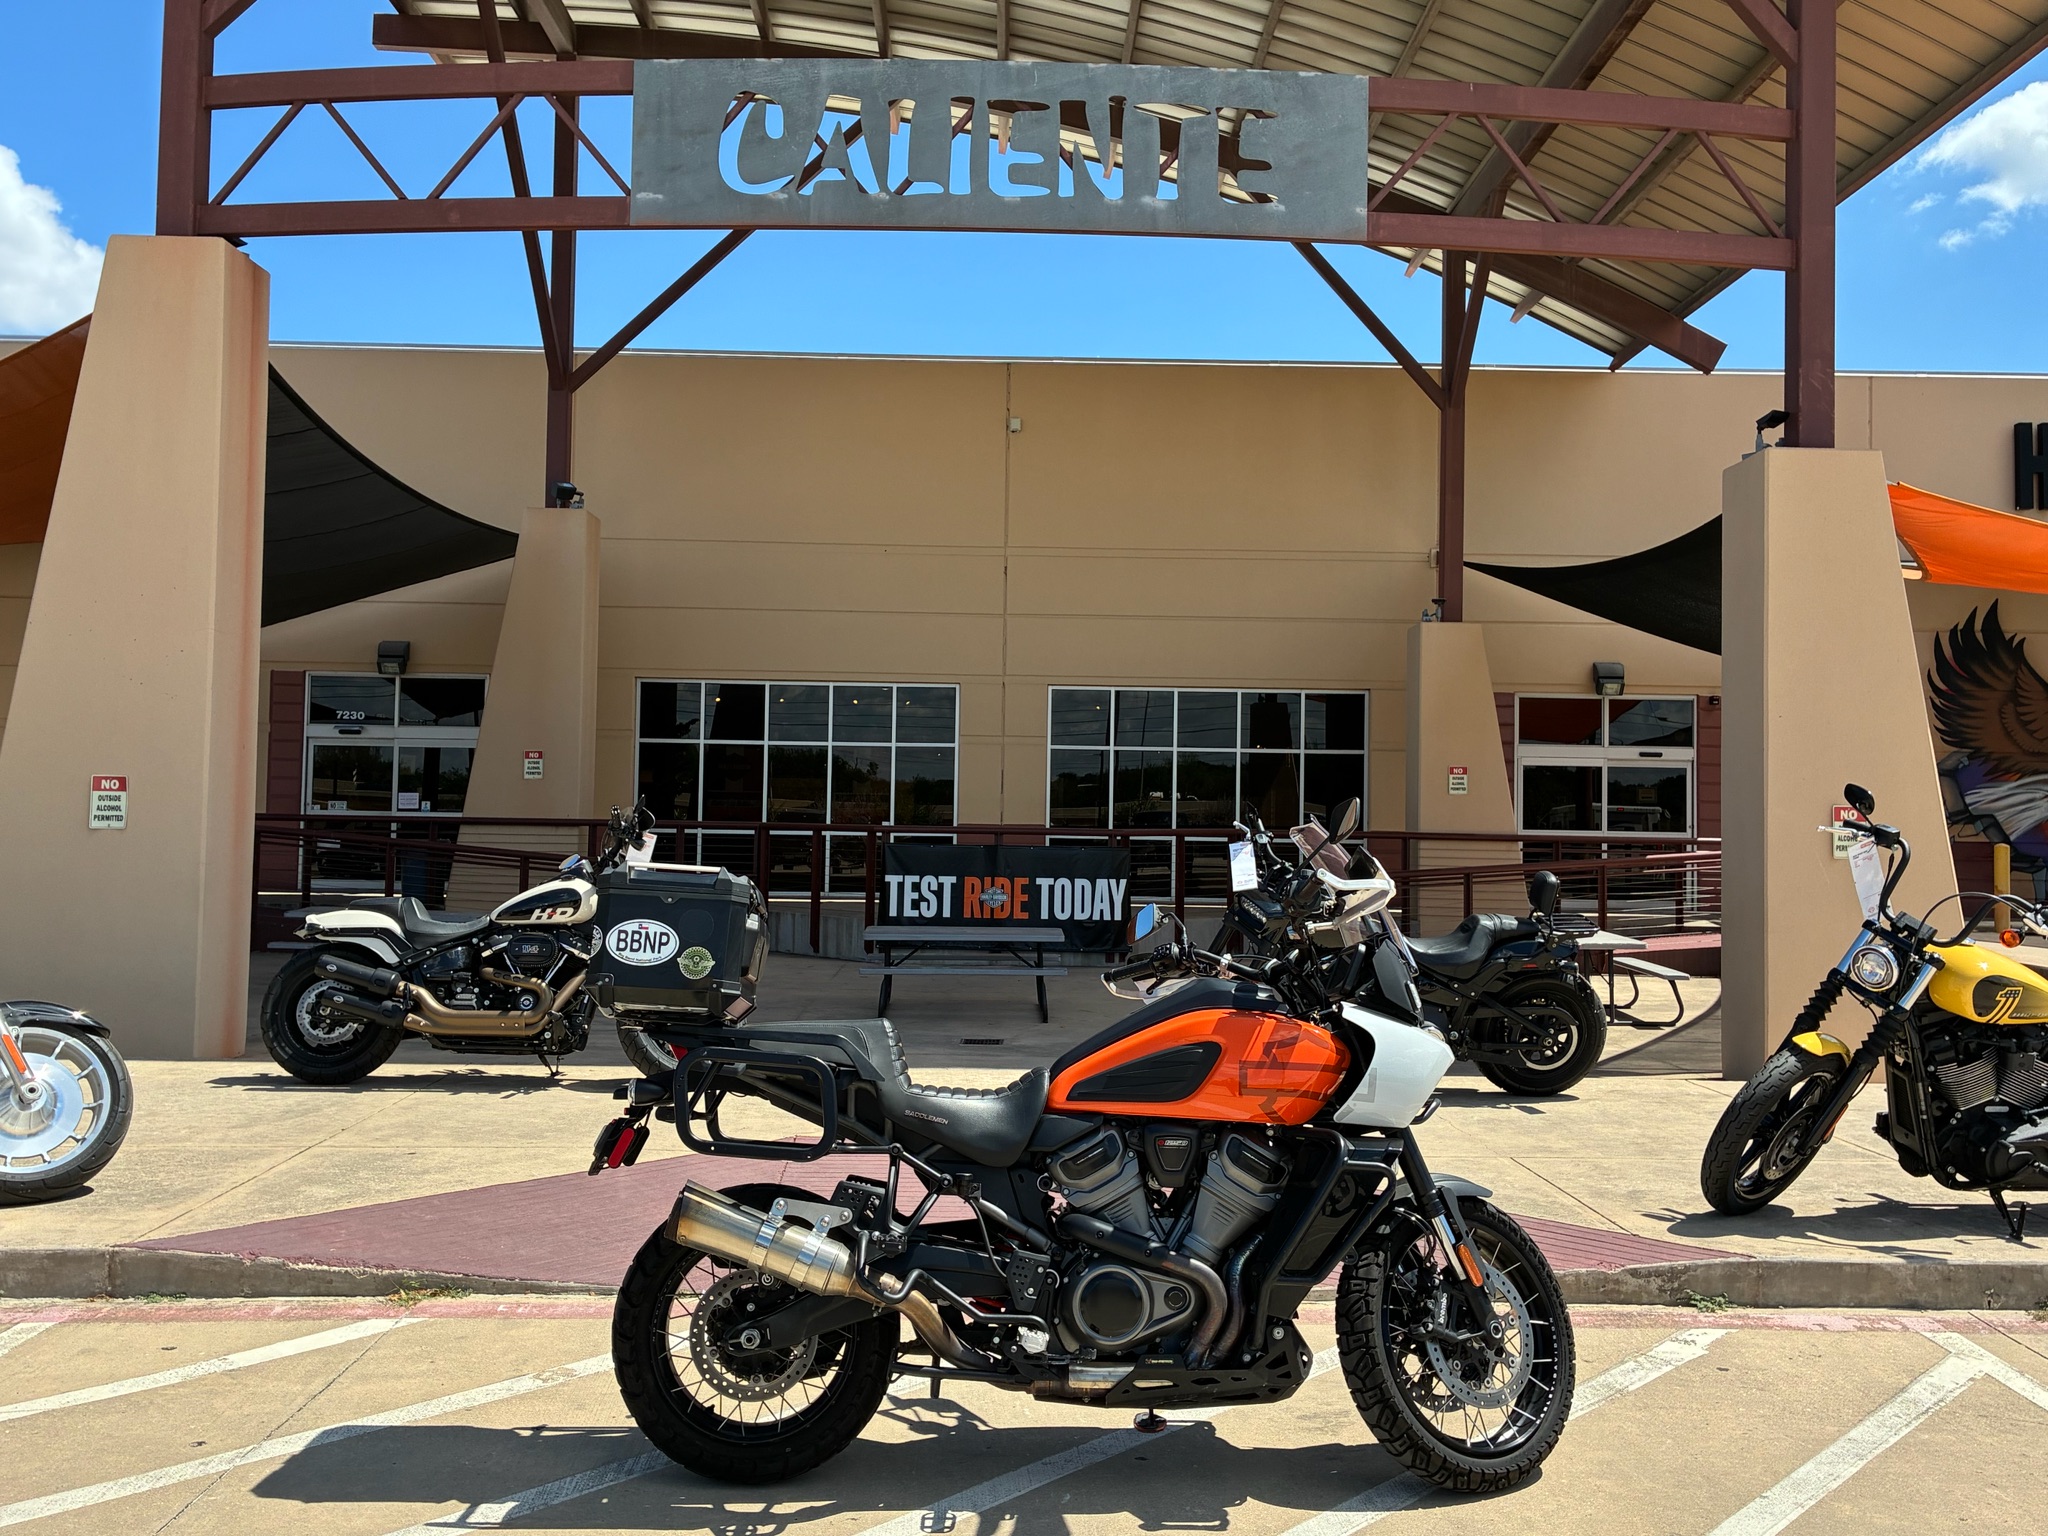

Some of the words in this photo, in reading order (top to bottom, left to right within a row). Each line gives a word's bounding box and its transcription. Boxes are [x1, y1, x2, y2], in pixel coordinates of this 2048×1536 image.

[718, 90, 1279, 204] CALIENTE
[336, 711, 365, 720] 7230
[101, 779, 120, 790] NO
[97, 794, 122, 802] OUTSIDE
[96, 804, 122, 812] ALCOHOL
[93, 814, 124, 822] PERMITTED
[1840, 809, 1858, 820] NO
[884, 874, 957, 918] TEST
[963, 876, 1030, 920] RIDE
[1035, 877, 1128, 921] TODAY
[615, 929, 671, 954] BBNP
[904, 1109, 949, 1125] SADDLEMEN
[1437, 1292, 1448, 1324] brembo
